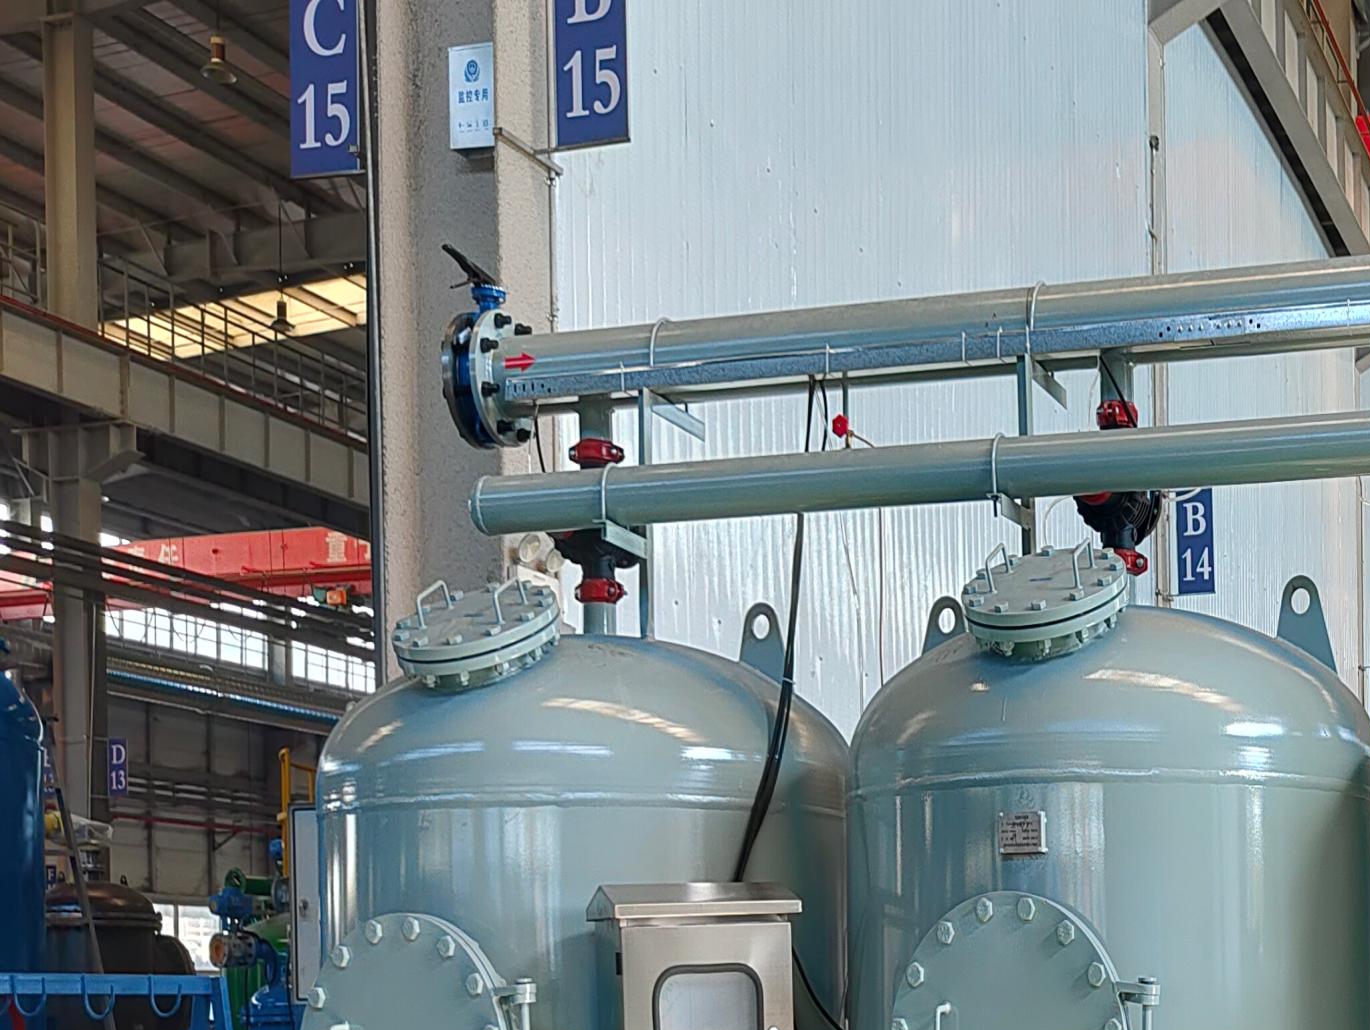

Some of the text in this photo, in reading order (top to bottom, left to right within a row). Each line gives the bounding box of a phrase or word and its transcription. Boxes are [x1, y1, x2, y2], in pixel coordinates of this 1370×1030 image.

[303, 0, 347, 56] C
[458, 88, 489, 104] 监控专用
[563, 45, 621, 118] 15
[297, 80, 351, 149] 15
[1182, 502, 1207, 536] B
[1181, 546, 1213, 581] 14
[111, 744, 126, 765] D
[110, 770, 126, 790] 13
